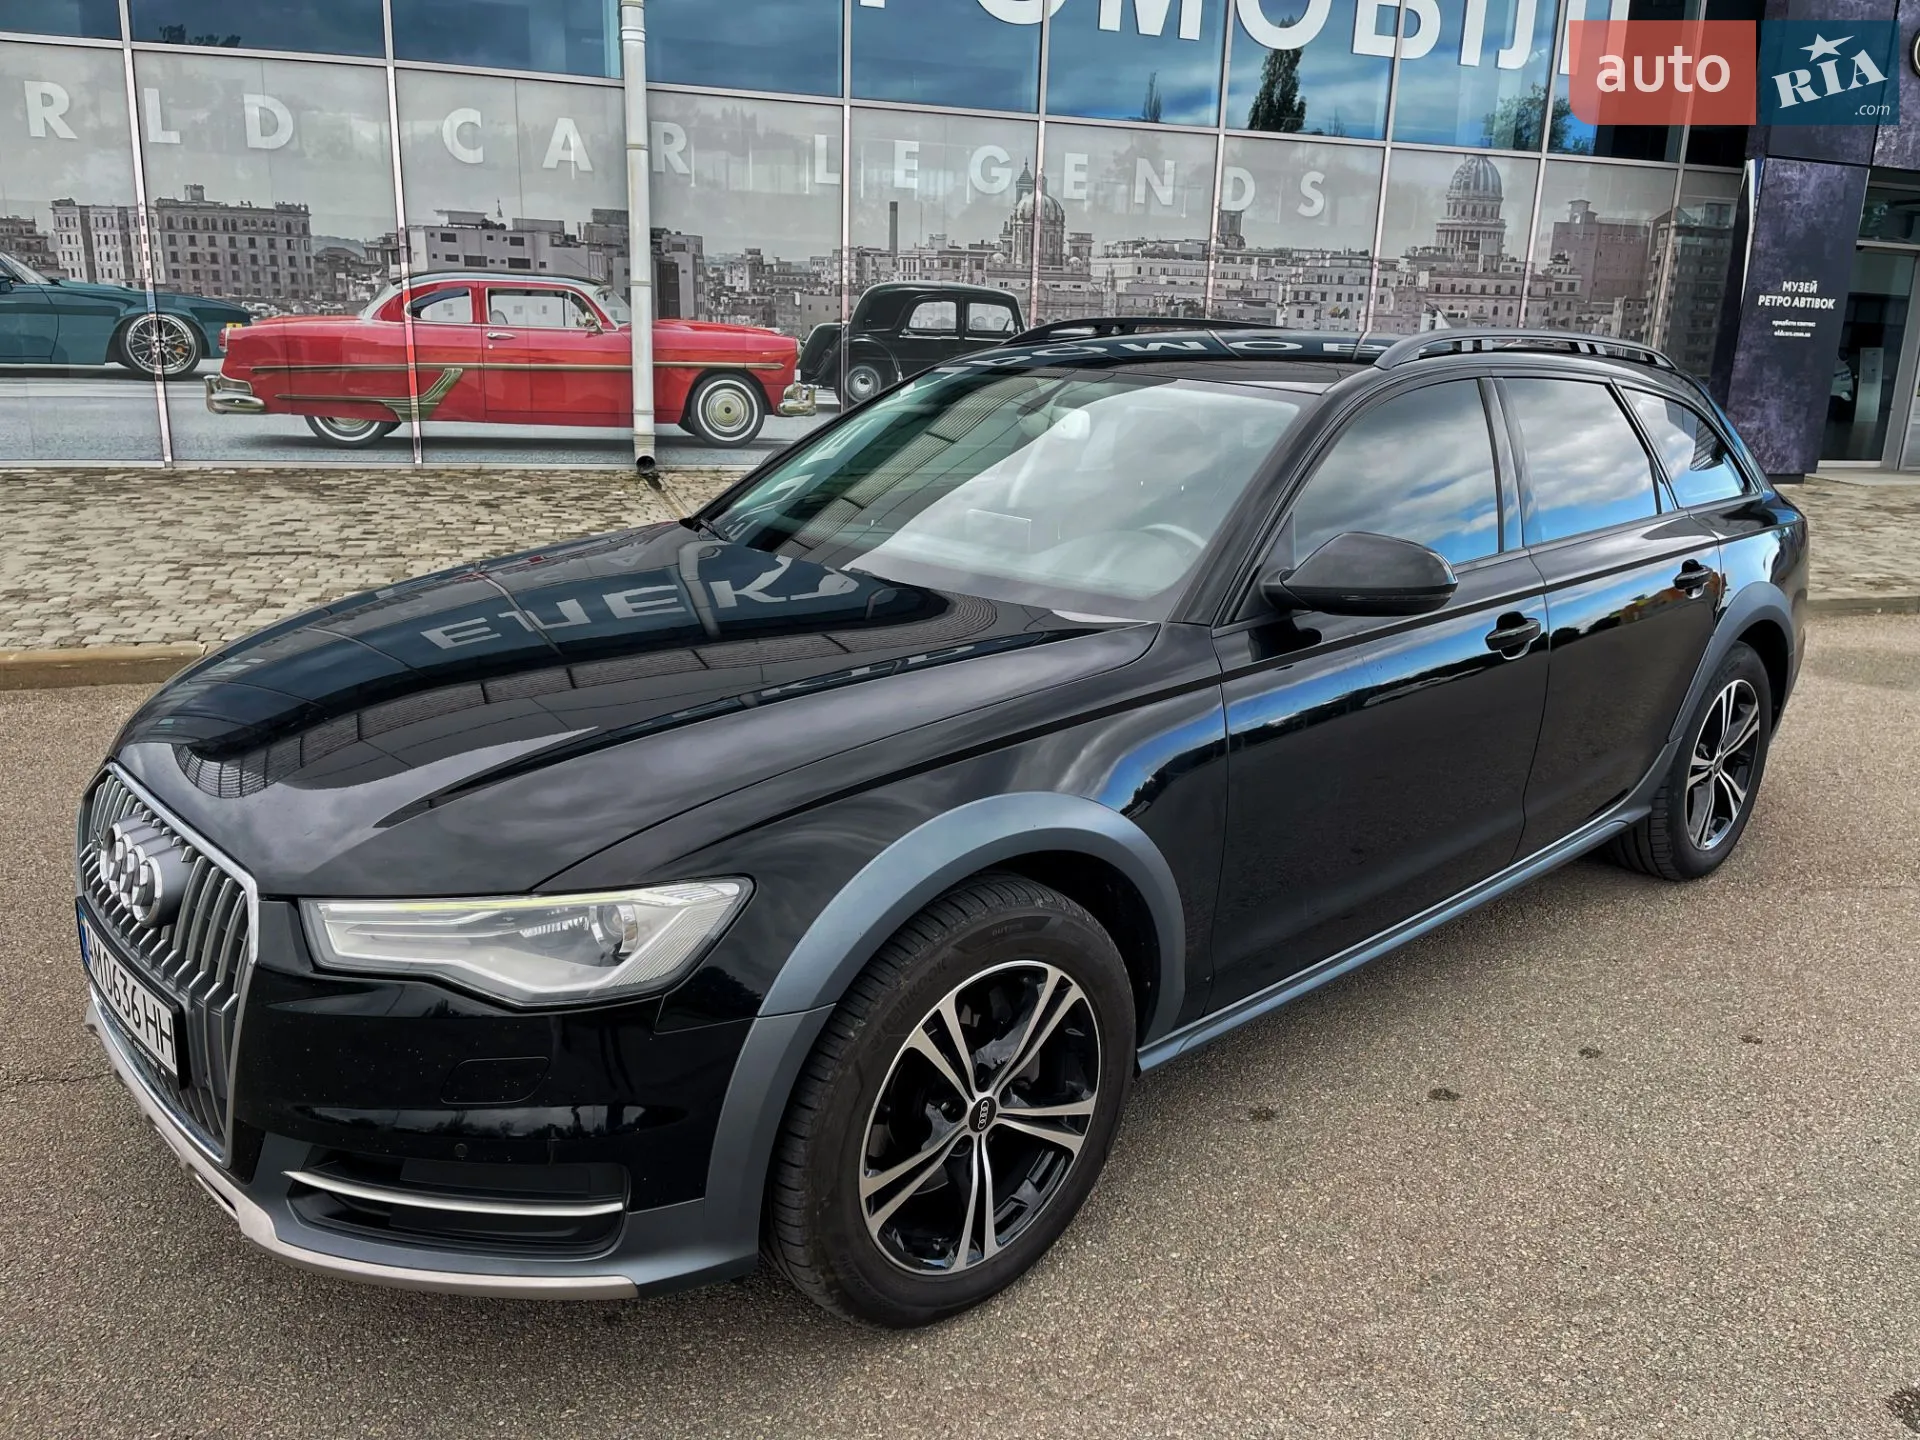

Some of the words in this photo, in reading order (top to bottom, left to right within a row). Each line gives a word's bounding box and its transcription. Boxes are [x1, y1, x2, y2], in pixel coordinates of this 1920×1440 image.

[441, 107, 692, 176] CAR
[814, 133, 1326, 218] LEGENDS
[1782, 280, 1818, 293] МУЗЕЙ
[1758, 294, 1791, 308] РЕТРО
[1791, 296, 1836, 310] АВТІВОК
